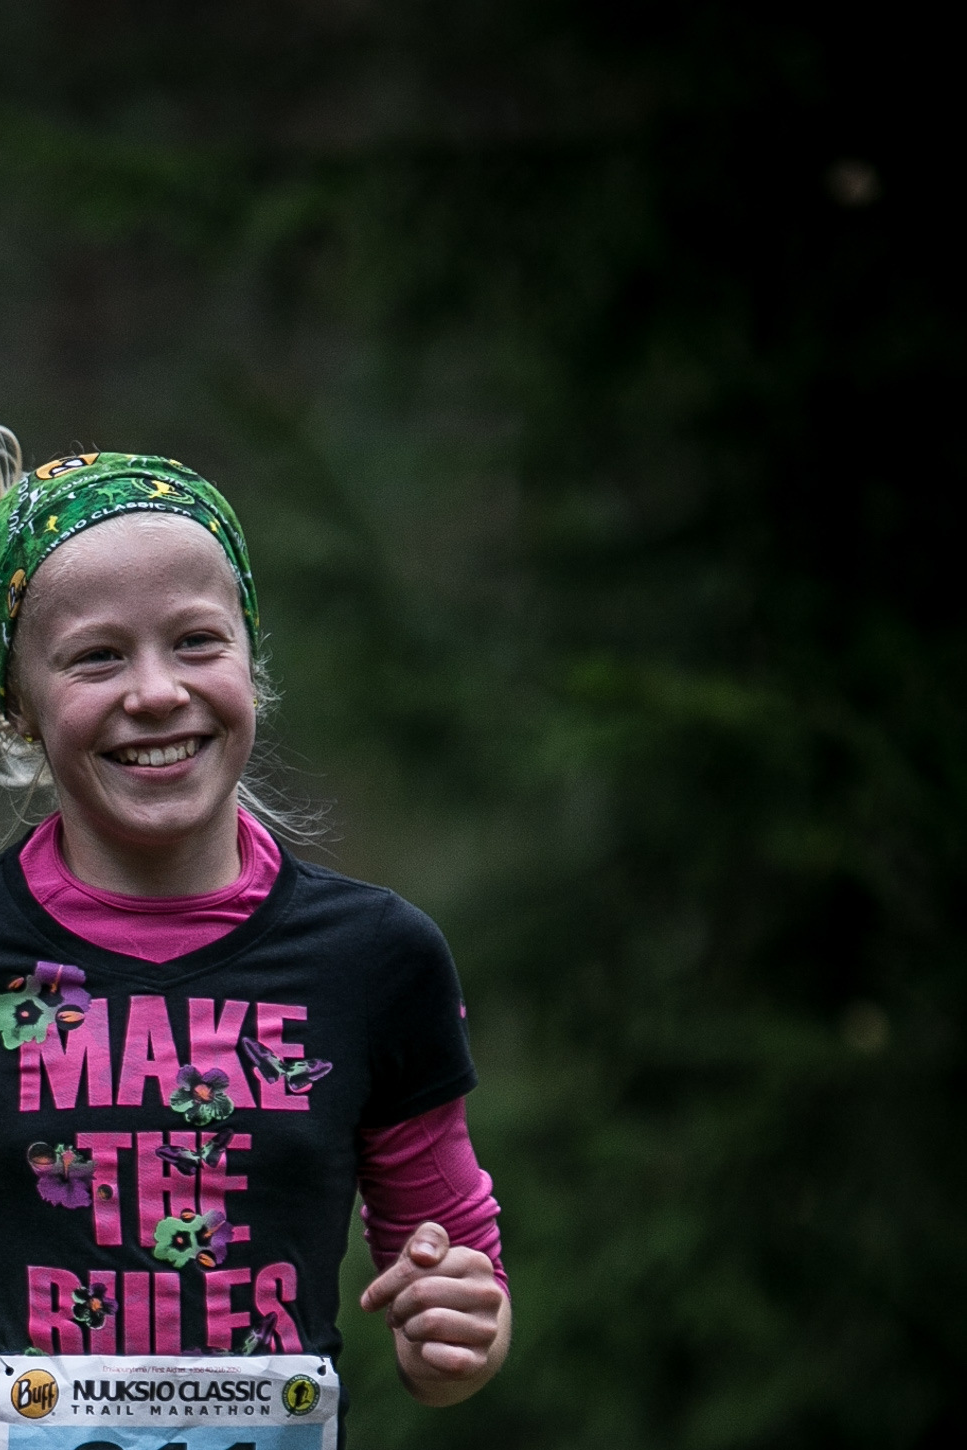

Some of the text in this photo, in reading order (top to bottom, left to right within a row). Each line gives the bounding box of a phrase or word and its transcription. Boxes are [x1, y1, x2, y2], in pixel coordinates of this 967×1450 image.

[19, 995, 311, 1112] MAKE
[75, 1131, 252, 1248] THE
[71, 1404, 271, 1416] TRAIL MARATHON
[73, 1380, 175, 1402] NUUKSIO
[178, 1380, 272, 1402] CLASSIC
